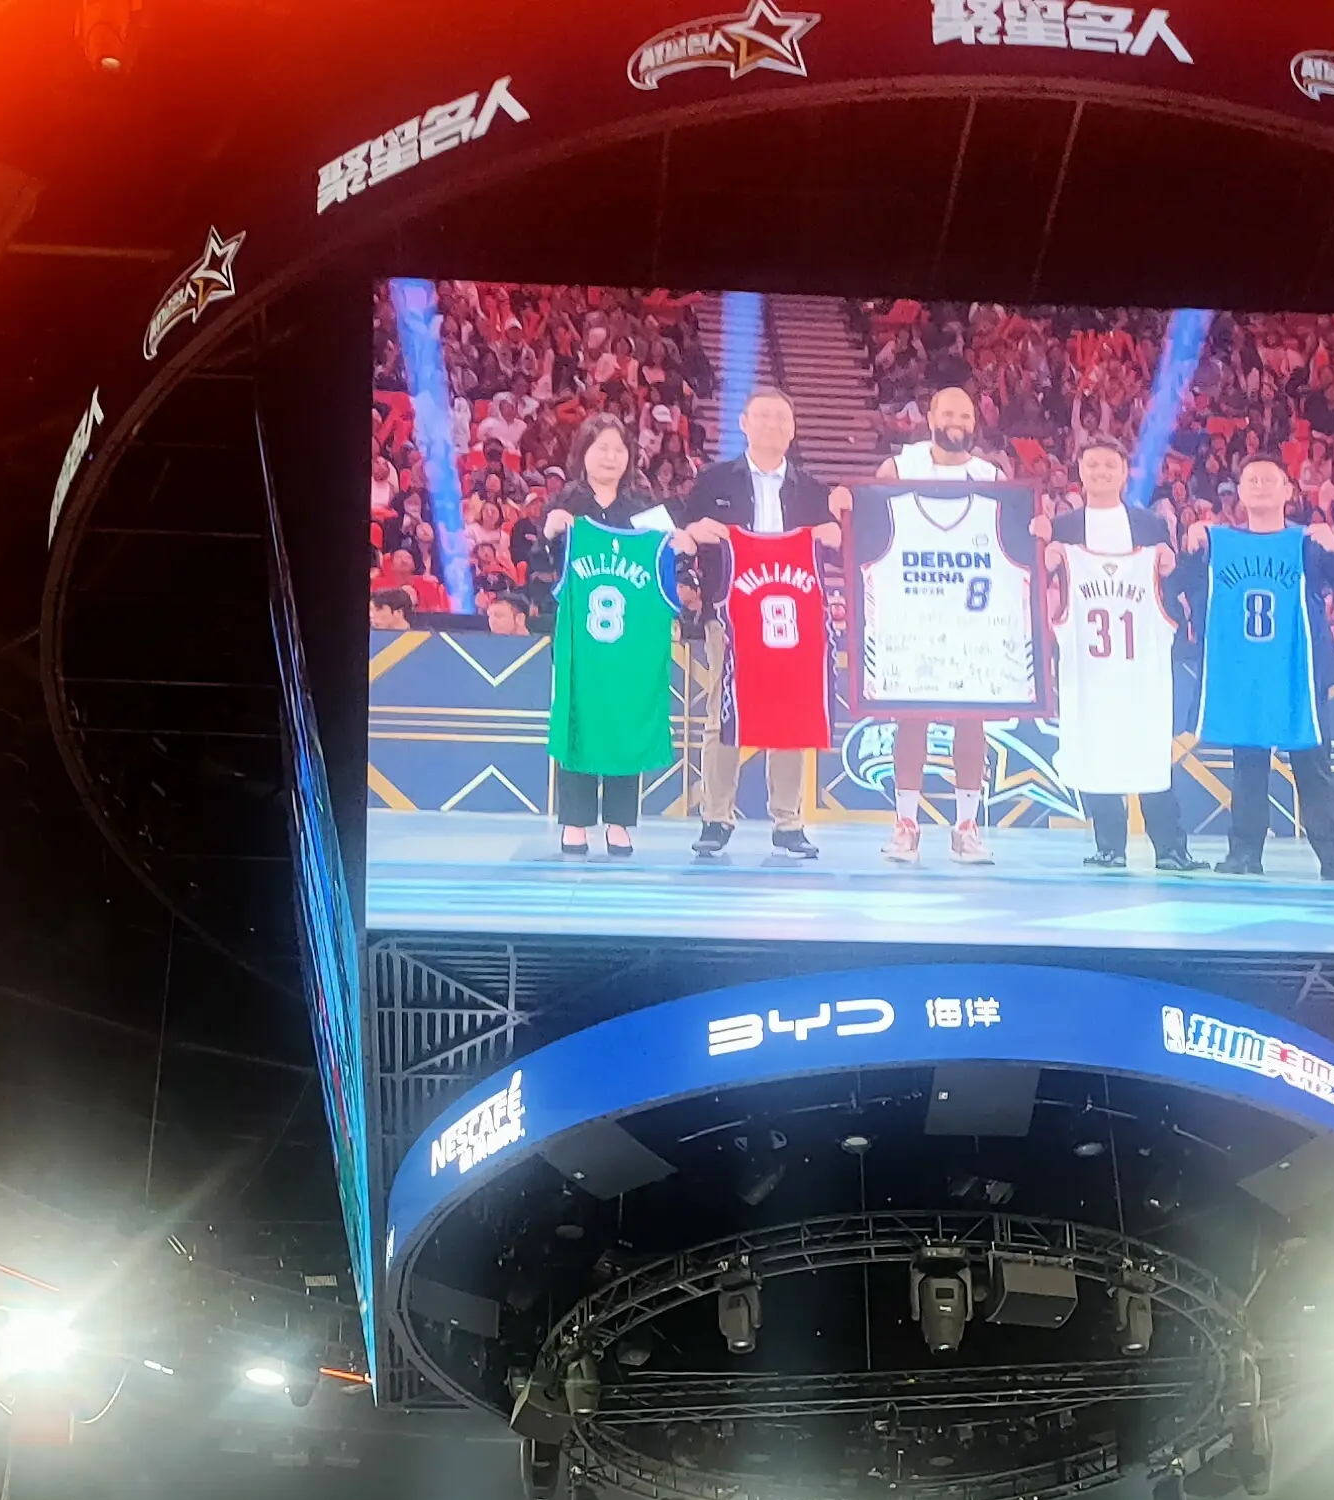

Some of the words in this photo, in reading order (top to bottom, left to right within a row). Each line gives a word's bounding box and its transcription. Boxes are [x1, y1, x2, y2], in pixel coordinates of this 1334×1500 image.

[572, 548, 651, 590] WILLIAMS
[901, 551, 992, 569] DERON
[902, 570, 965, 584] CHINA
[1218, 556, 1303, 591] WILLIAMS
[735, 563, 817, 596] WILLIAMS
[966, 576, 992, 611] 8
[1078, 580, 1147, 604] WILLIAMS
[586, 584, 626, 643] 8
[760, 594, 799, 649] 8
[1243, 589, 1275, 642] 8
[1087, 608, 1136, 660] 31
[708, 998, 895, 1057] BYD
[925, 996, 1001, 1029] 海洋
